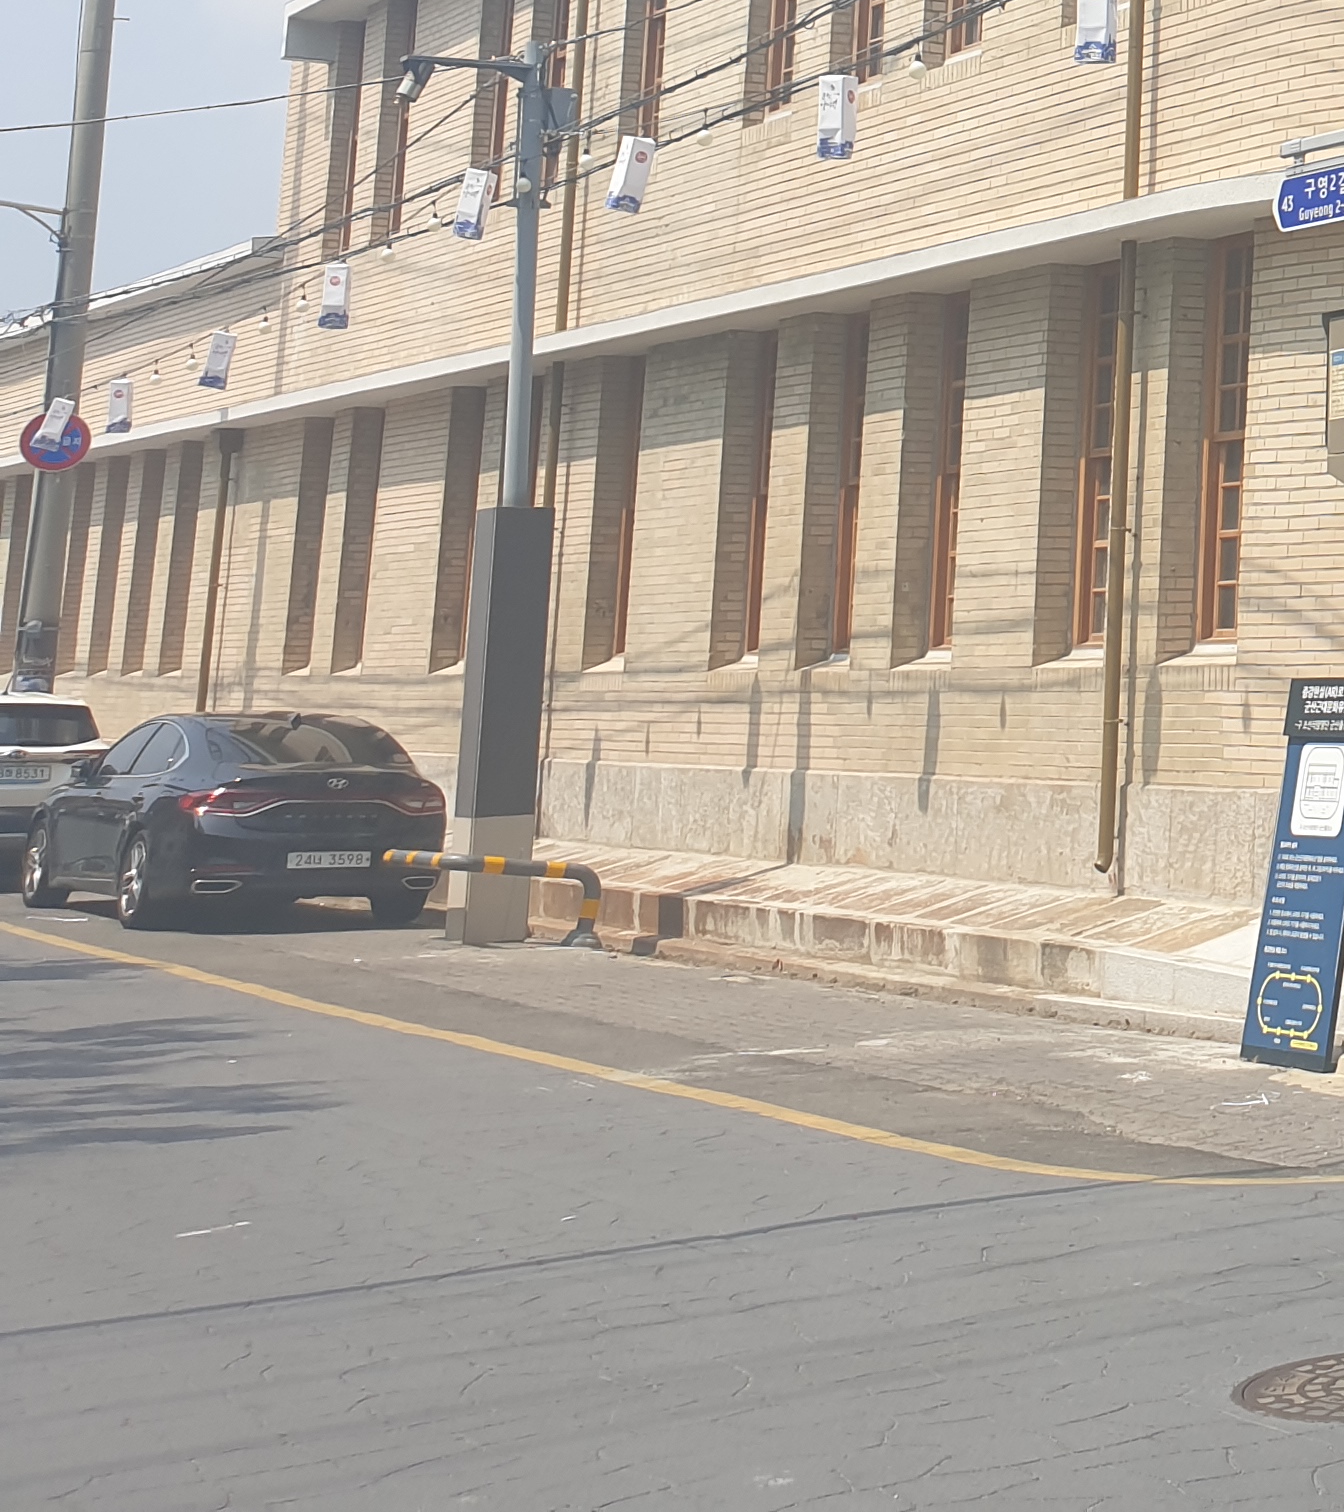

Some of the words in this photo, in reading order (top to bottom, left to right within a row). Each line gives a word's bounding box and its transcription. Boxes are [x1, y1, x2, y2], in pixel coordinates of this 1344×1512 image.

[1281, 194, 1295, 213] 43
[1298, 205, 1335, 222] Guyeong
[328, 853, 364, 866] 3598
